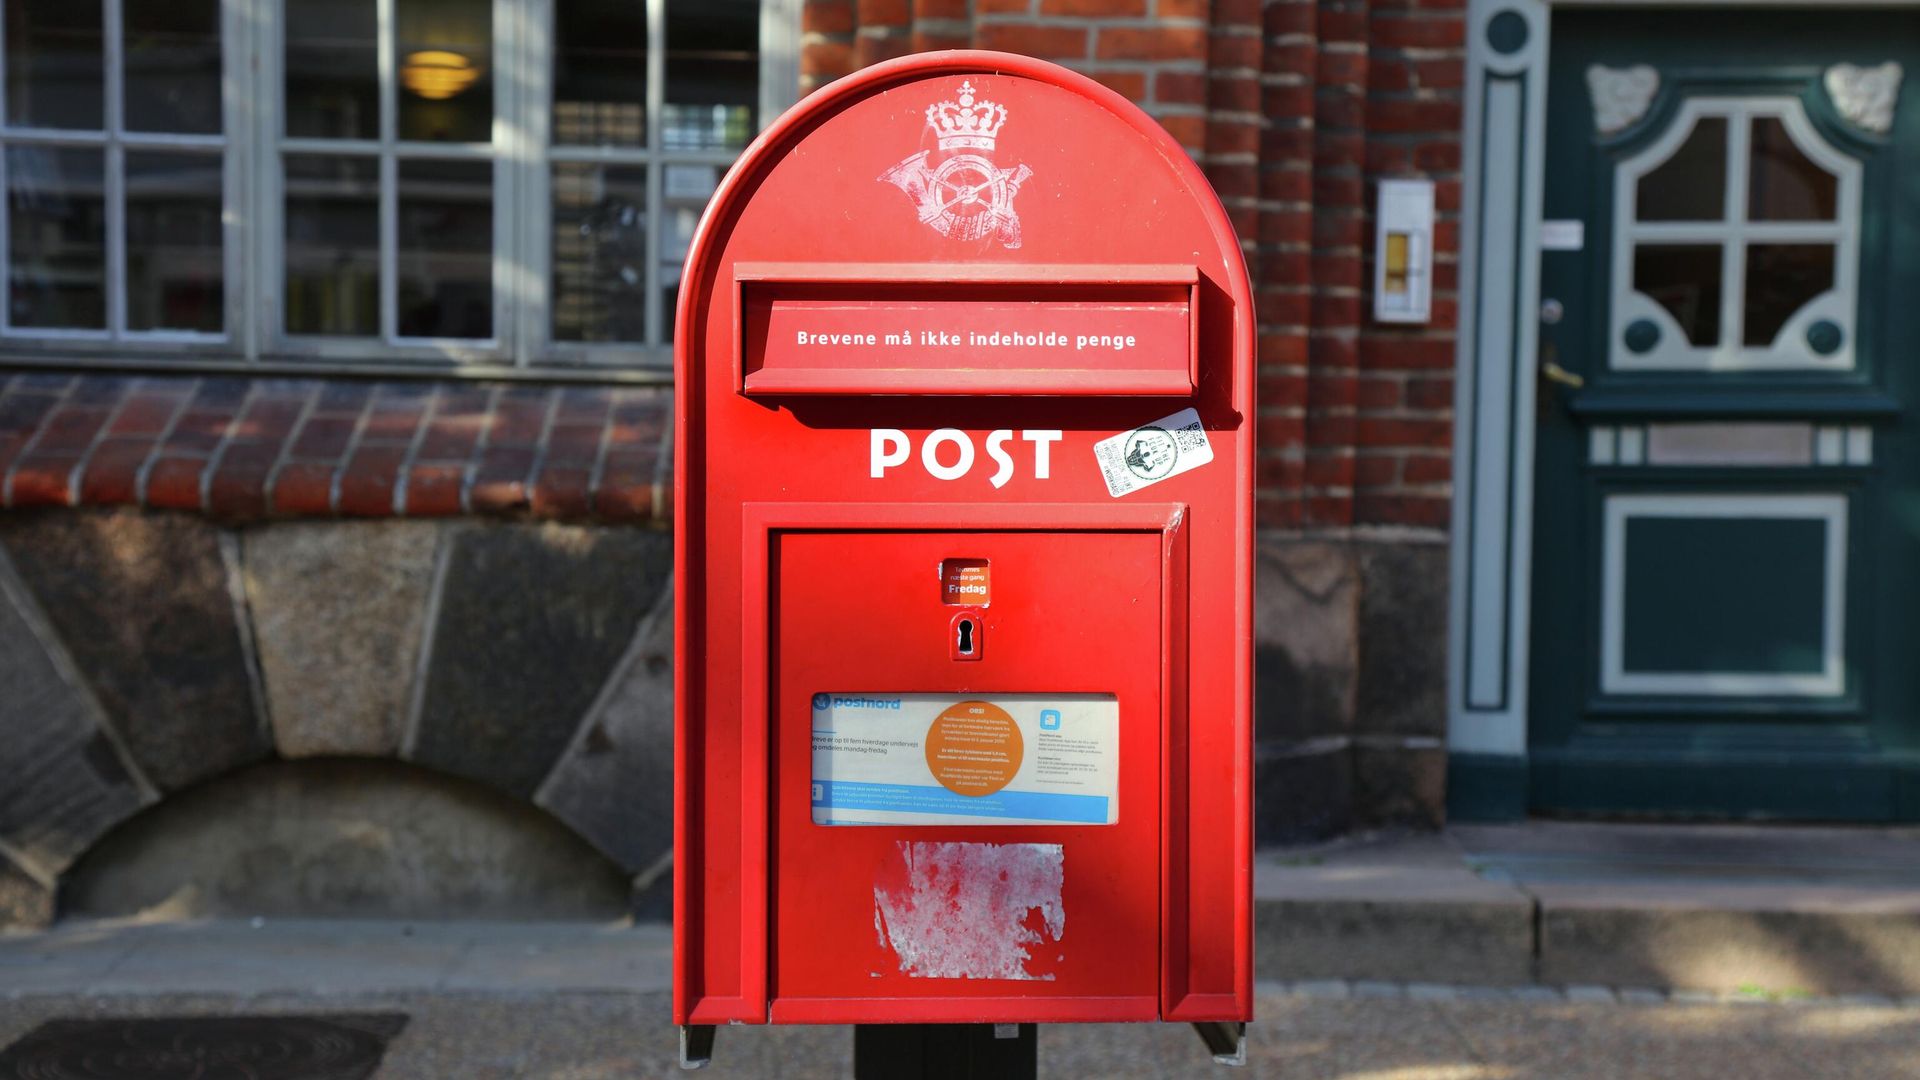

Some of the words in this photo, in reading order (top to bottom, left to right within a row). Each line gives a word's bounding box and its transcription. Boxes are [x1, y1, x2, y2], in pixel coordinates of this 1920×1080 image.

[797, 331, 876, 346] Brevene
[885, 330, 912, 346] må
[920, 330, 961, 346] ikke
[969, 331, 1068, 347] indeholde
[1077, 334, 1137, 350] penge
[870, 427, 1063, 489] POST
[1154, 456, 1163, 466] UP
[1160, 449, 1170, 462] THE
[948, 584, 986, 595] Fredag
[833, 697, 901, 710] postnord
[862, 739, 889, 747] hverdage
